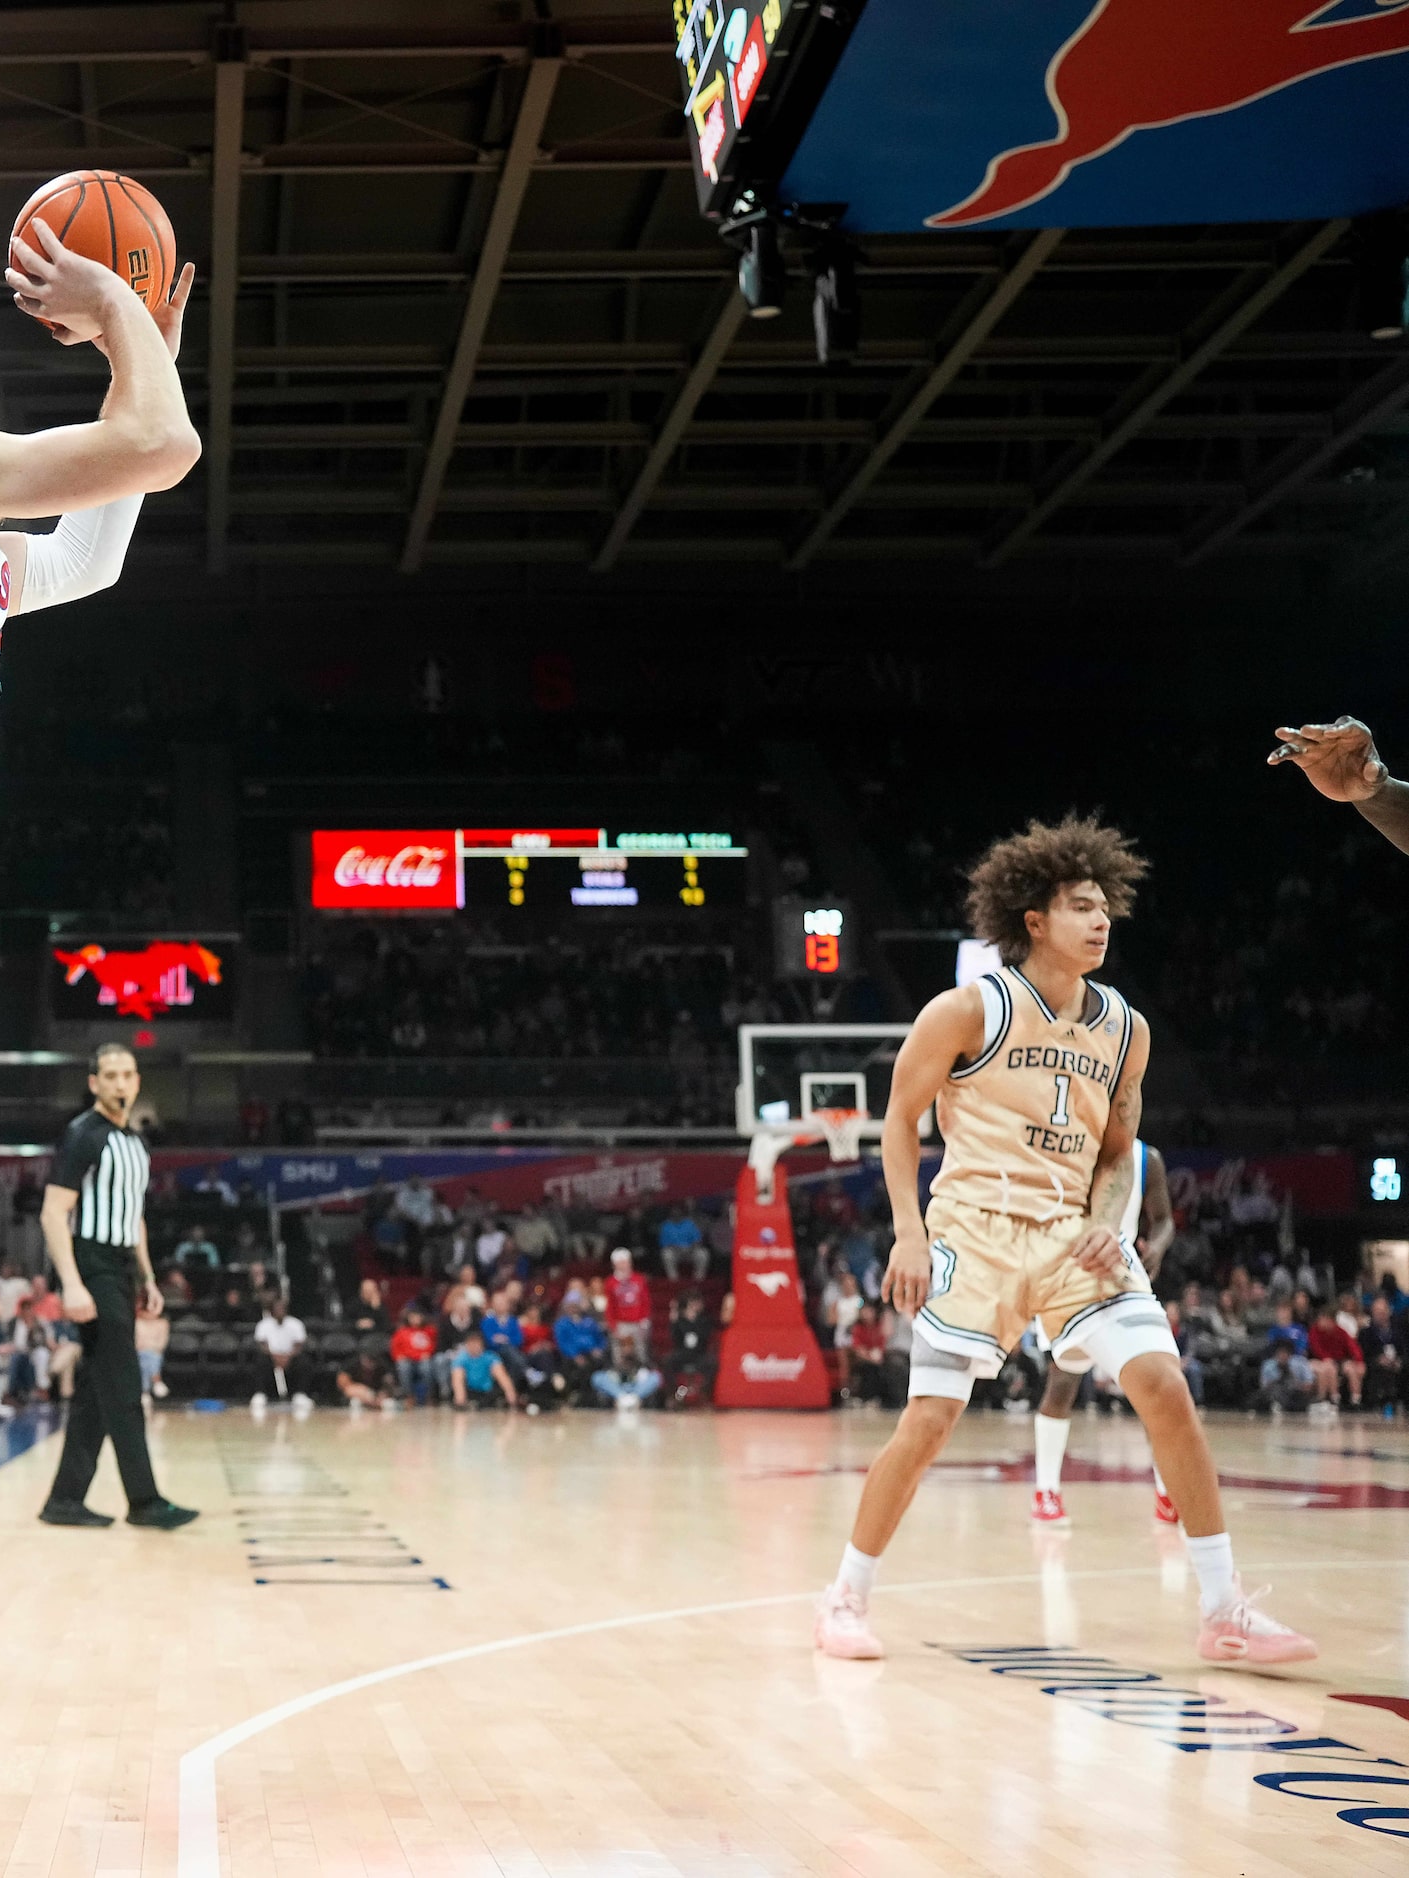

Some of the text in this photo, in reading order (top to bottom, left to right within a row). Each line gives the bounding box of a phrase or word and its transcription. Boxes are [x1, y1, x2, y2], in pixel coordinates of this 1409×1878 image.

[805, 934, 840, 973] 13
[1007, 1046, 1111, 1087] GEORGIA
[1050, 1074, 1071, 1126] 1
[1025, 1125, 1087, 1154] TECH
